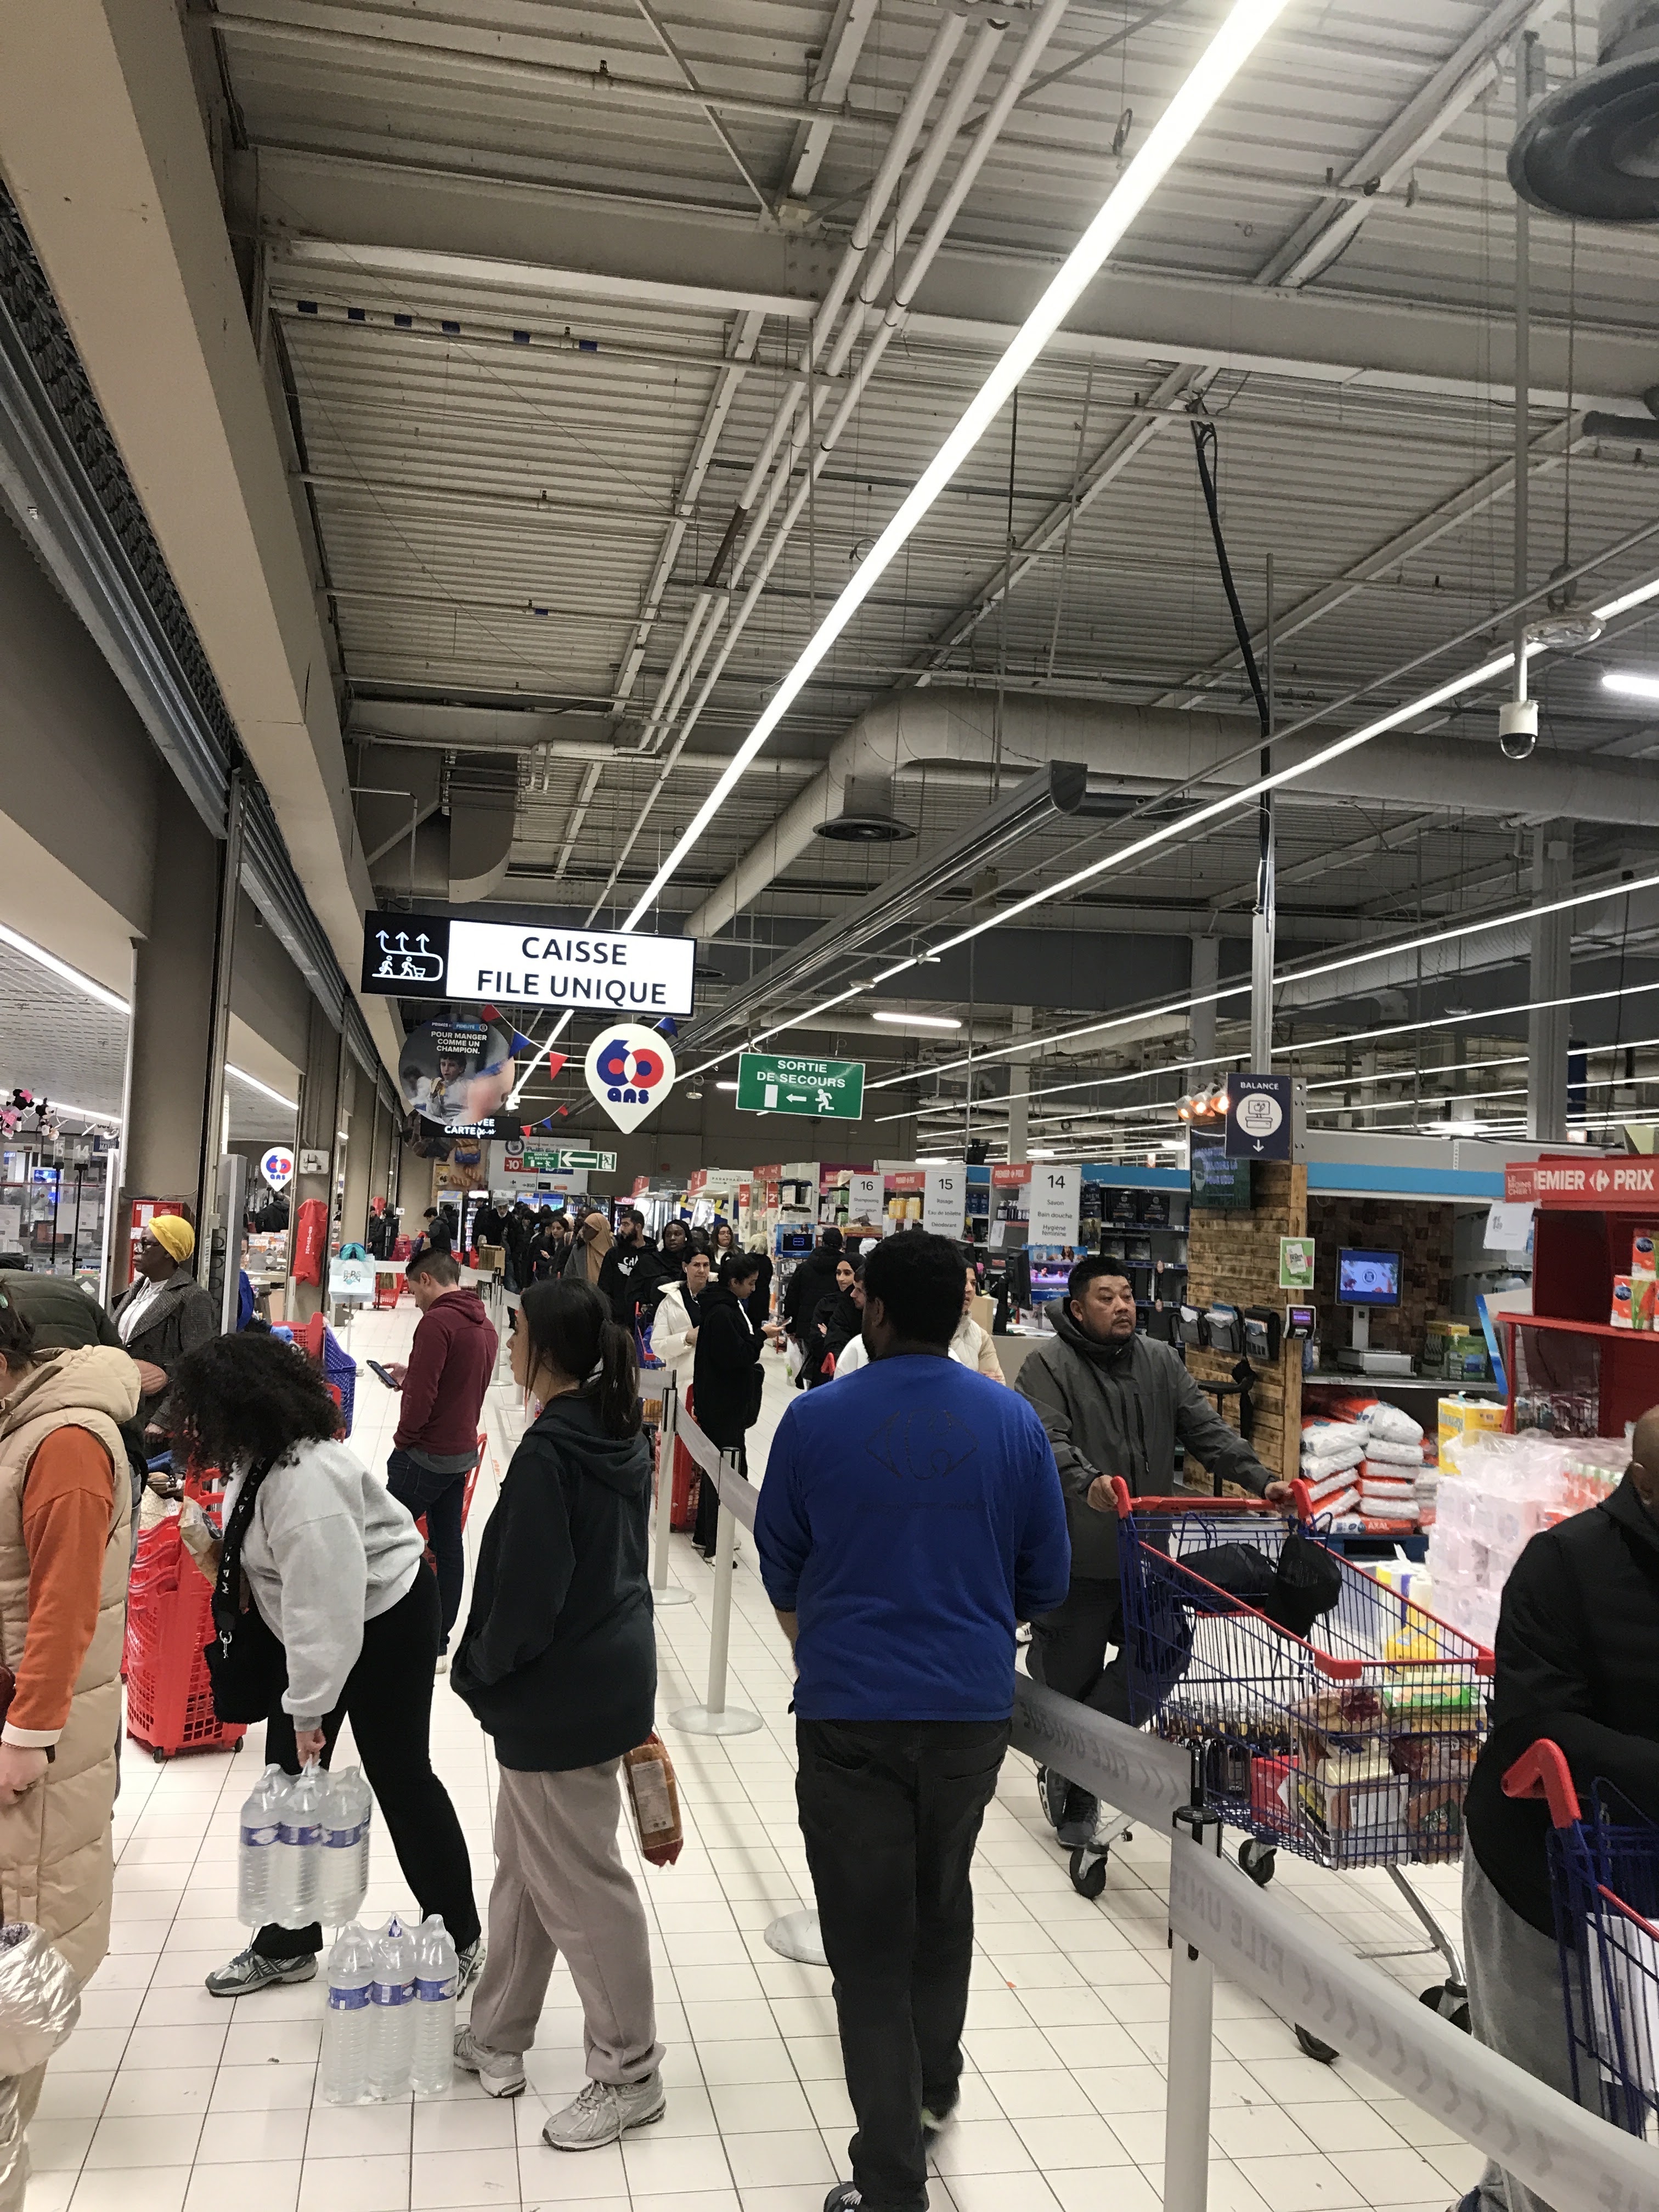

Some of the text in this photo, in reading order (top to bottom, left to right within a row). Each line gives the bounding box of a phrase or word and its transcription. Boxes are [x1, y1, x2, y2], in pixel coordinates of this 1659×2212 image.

[522, 936, 627, 966] CAISSE
[477, 969, 667, 1008] FILE UNIQUE
[454, 1032, 487, 1041] MANGER
[436, 1045, 481, 1054] CHAMPION.
[596, 1039, 664, 1088] 60
[777, 1060, 827, 1073] SORTIE
[757, 1071, 846, 1088] DE SECOURS
[1240, 1081, 1279, 1091] BALANCE
[607, 1088, 650, 1104] ans
[444, 1126, 476, 1135] CARTE
[75, 1144, 90, 1159] 14
[266, 1155, 292, 1174] 60
[861, 1181, 873, 1191] 16
[939, 1178, 953, 1190] 15
[1047, 1175, 1065, 1189] 14
[1534, 1169, 1655, 1190] EMIER PRIX
